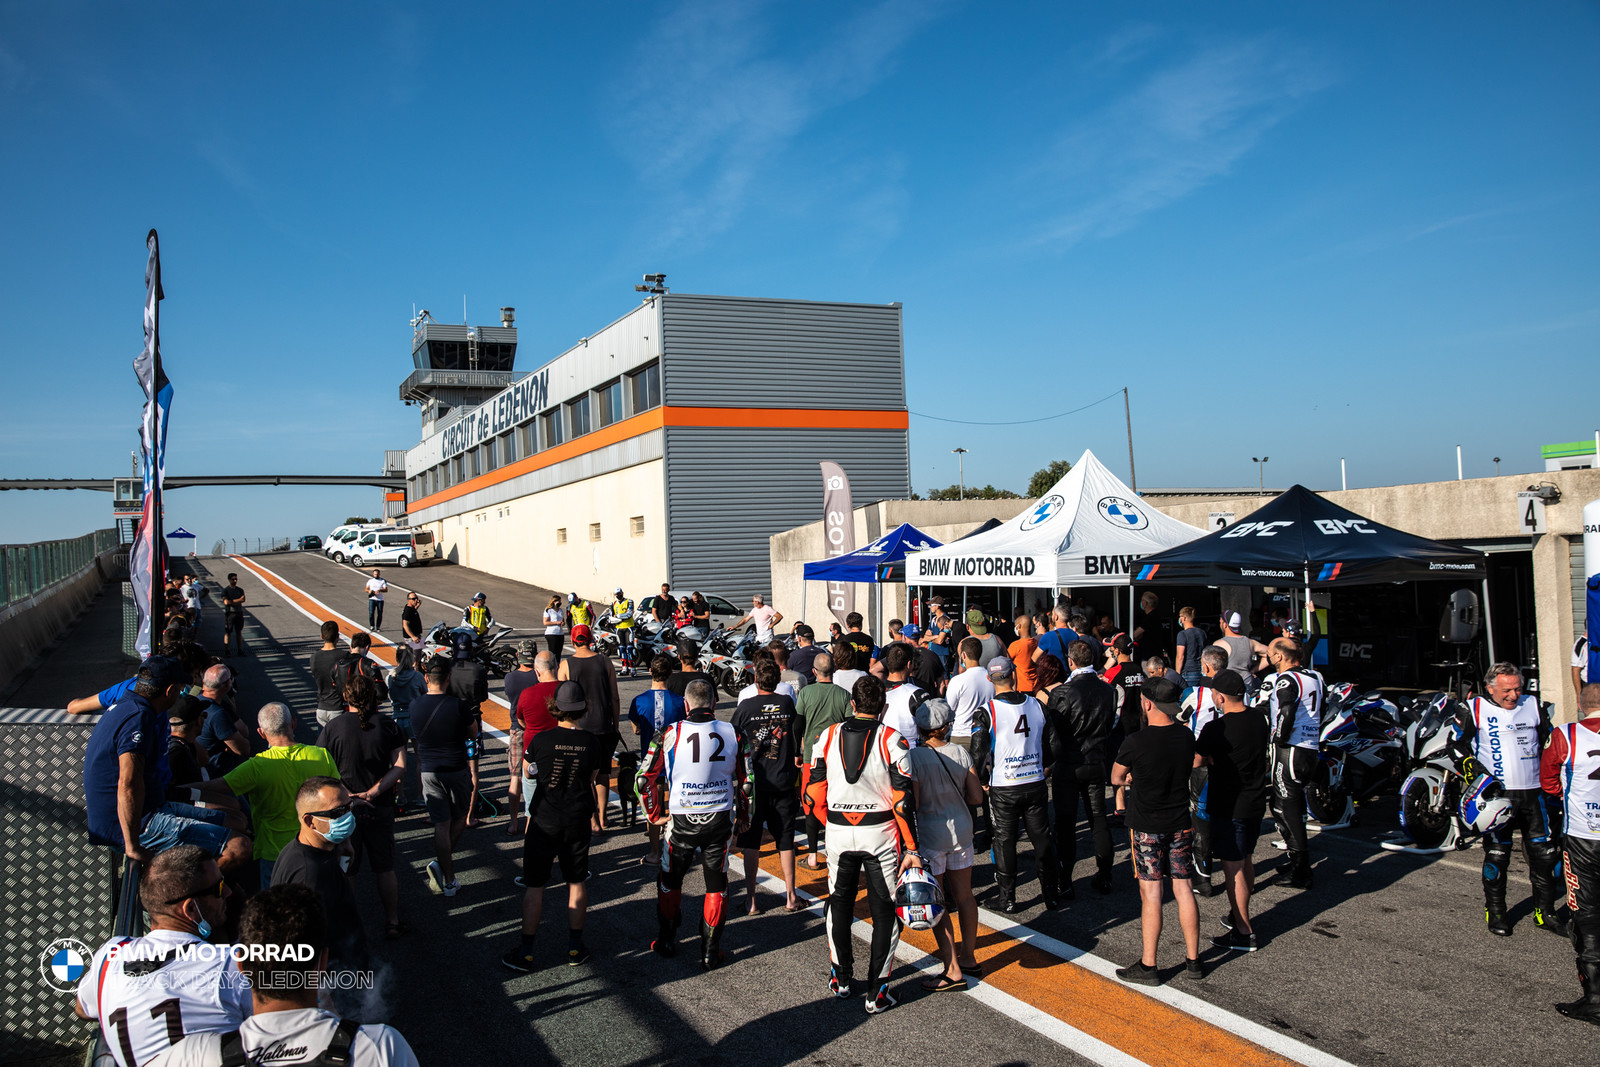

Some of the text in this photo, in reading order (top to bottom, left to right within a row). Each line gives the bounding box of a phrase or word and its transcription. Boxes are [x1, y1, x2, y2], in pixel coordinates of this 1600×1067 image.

[442, 368, 549, 459] CIRCUIT de LEDENON
[1525, 499, 1537, 532] 4
[1220, 521, 1295, 539] BMC
[1313, 519, 1377, 535] BMC
[919, 556, 1035, 576] BMW MOTORRAD
[1240, 567, 1295, 578] bmc-moto.com
[1339, 642, 1373, 659] BMC
[1014, 713, 1031, 738] 4
[686, 732, 726, 764] 12
[681, 779, 729, 790] TRACKDAYS
[702, 788, 729, 796] MOTORRAD
[692, 798, 729, 806] MICHELIN
[831, 802, 879, 811] DAINESE
[108, 997, 185, 1067] 11
[247, 1040, 308, 1064] Hallman
